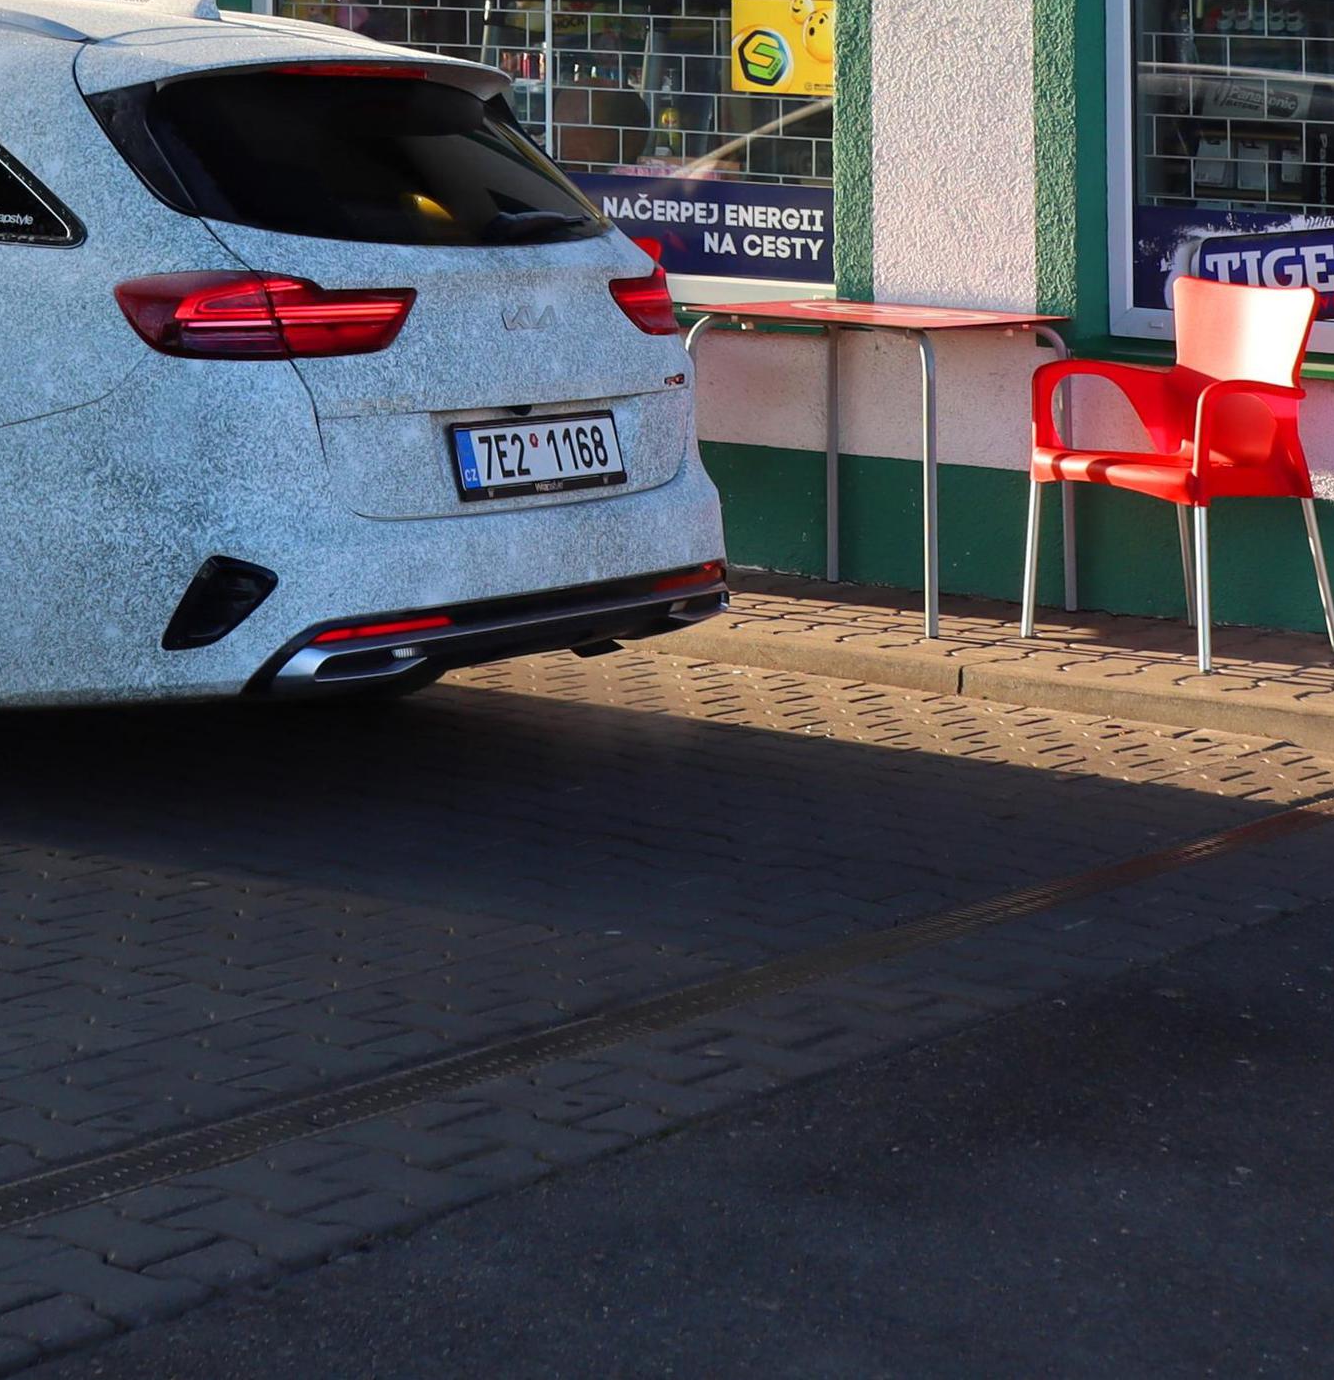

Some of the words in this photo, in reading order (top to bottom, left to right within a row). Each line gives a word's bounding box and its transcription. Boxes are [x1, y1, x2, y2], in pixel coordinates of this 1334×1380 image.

[603, 193, 719, 224] NAČERPEJ
[724, 205, 824, 232] ENERGII
[704, 232, 737, 255] NA
[743, 234, 824, 261] CESTY
[464, 468, 478, 482] CZ
[478, 433, 531, 480] 7E2
[546, 425, 609, 472] 1168
